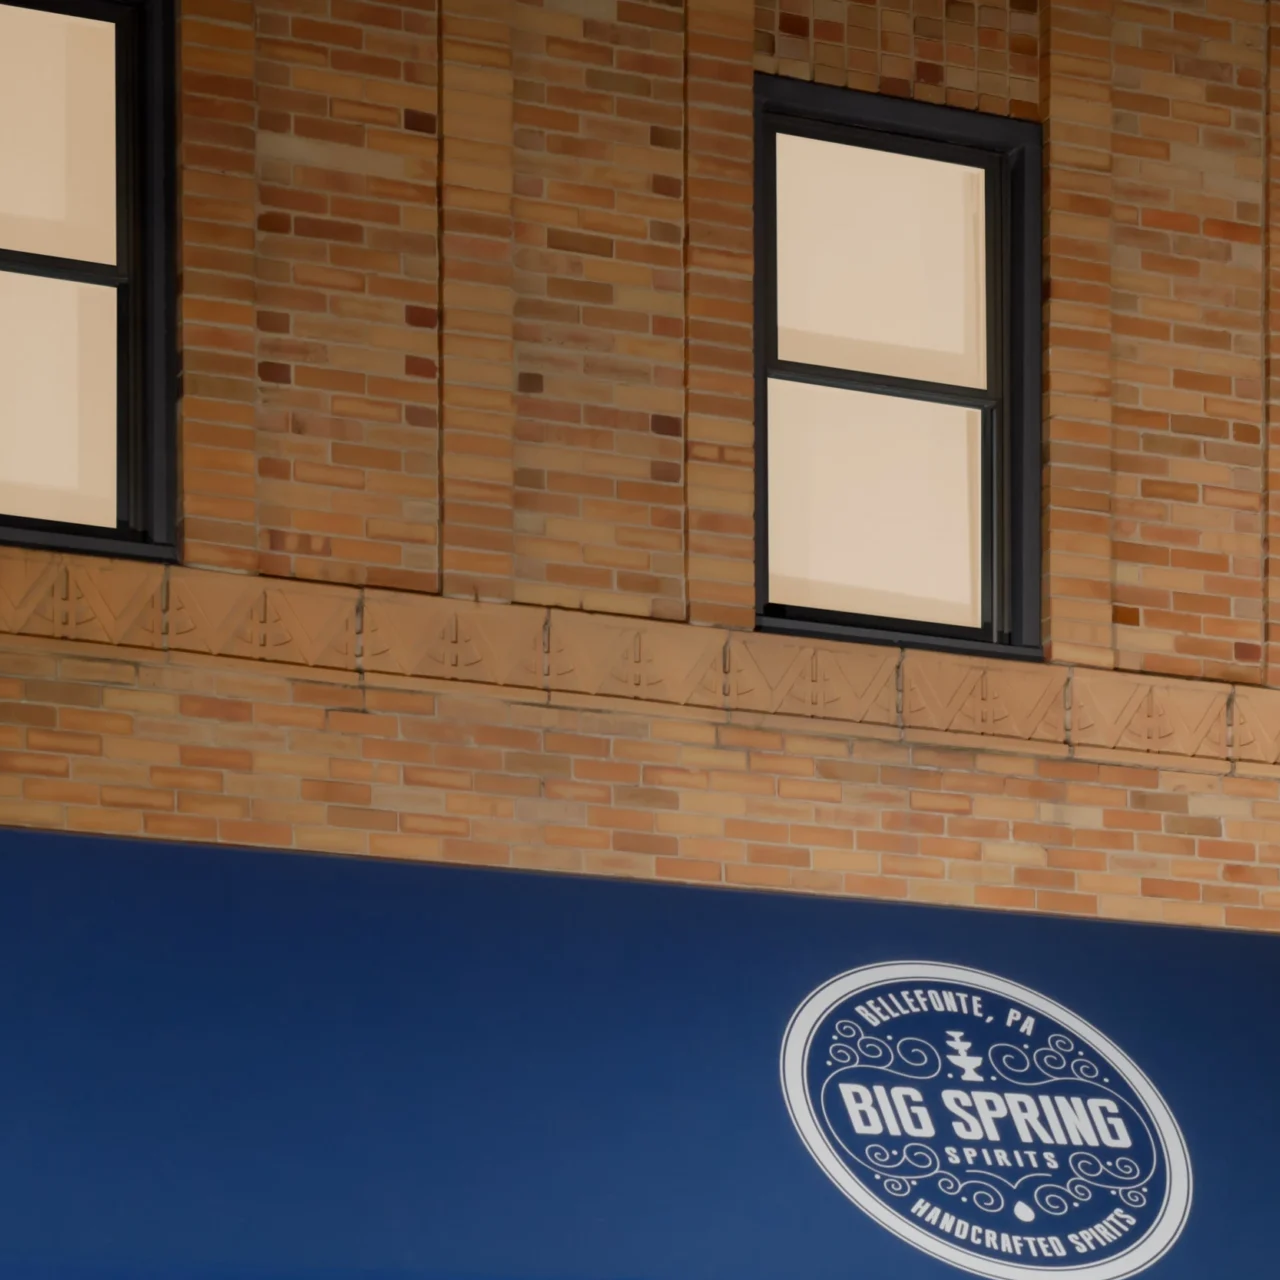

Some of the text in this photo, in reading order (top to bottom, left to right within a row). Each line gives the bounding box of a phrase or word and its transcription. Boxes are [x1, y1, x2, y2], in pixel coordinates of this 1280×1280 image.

[854, 989, 1036, 1036] BELLEFONTE, PA
[837, 1082, 1133, 1149] BIG SPRING
[943, 1145, 1060, 1170] SPIRITS
[909, 1198, 1137, 1258] HANDCRAFTED SPIRITS
